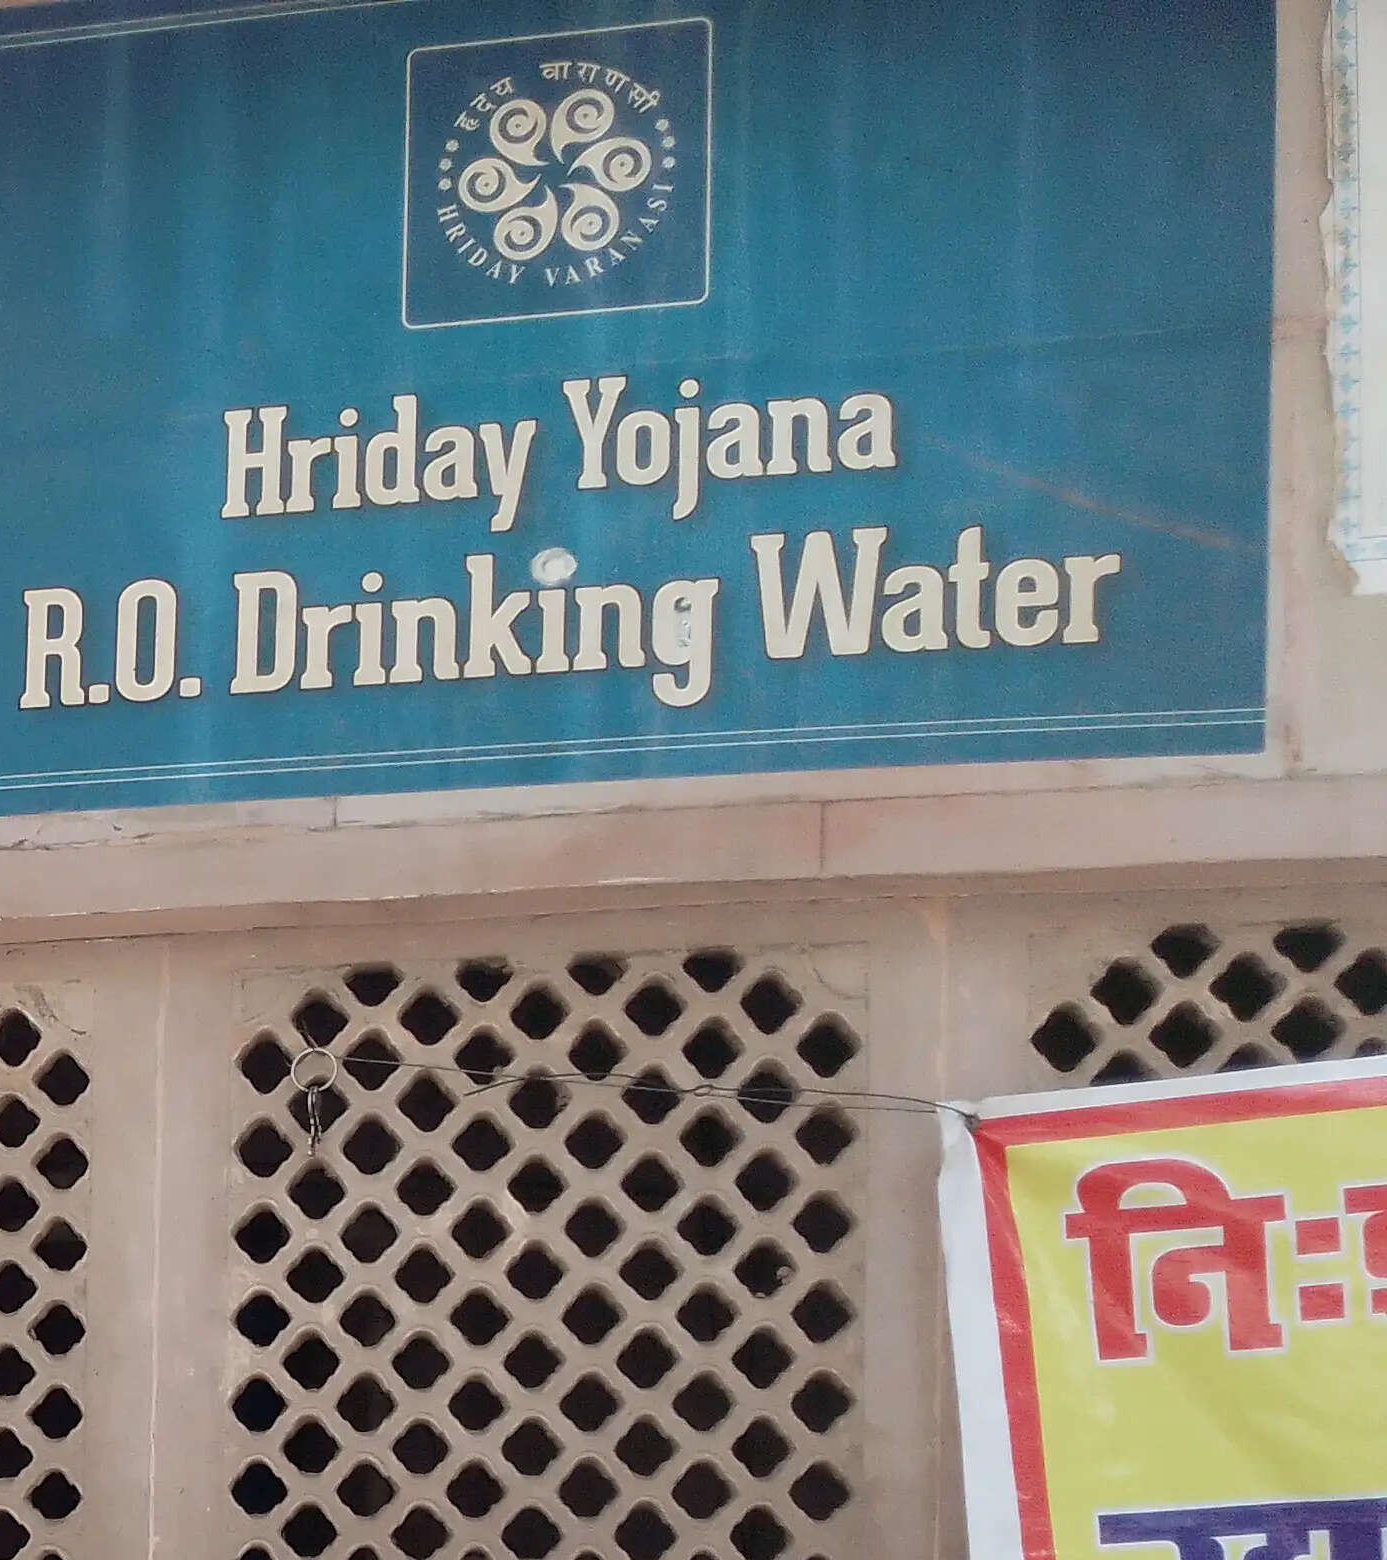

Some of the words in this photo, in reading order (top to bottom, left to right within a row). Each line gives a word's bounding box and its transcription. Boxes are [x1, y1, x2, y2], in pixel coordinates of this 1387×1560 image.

[539, 61, 661, 114] वाराणसी
[437, 203, 525, 285] HRIDAY
[545, 183, 674, 287] VARANASI
[219, 394, 538, 532] Hriday
[562, 375, 898, 520] Yojana
[18, 578, 201, 711] R.O.
[230, 552, 720, 708] Drinking
[751, 524, 1123, 662] Water
